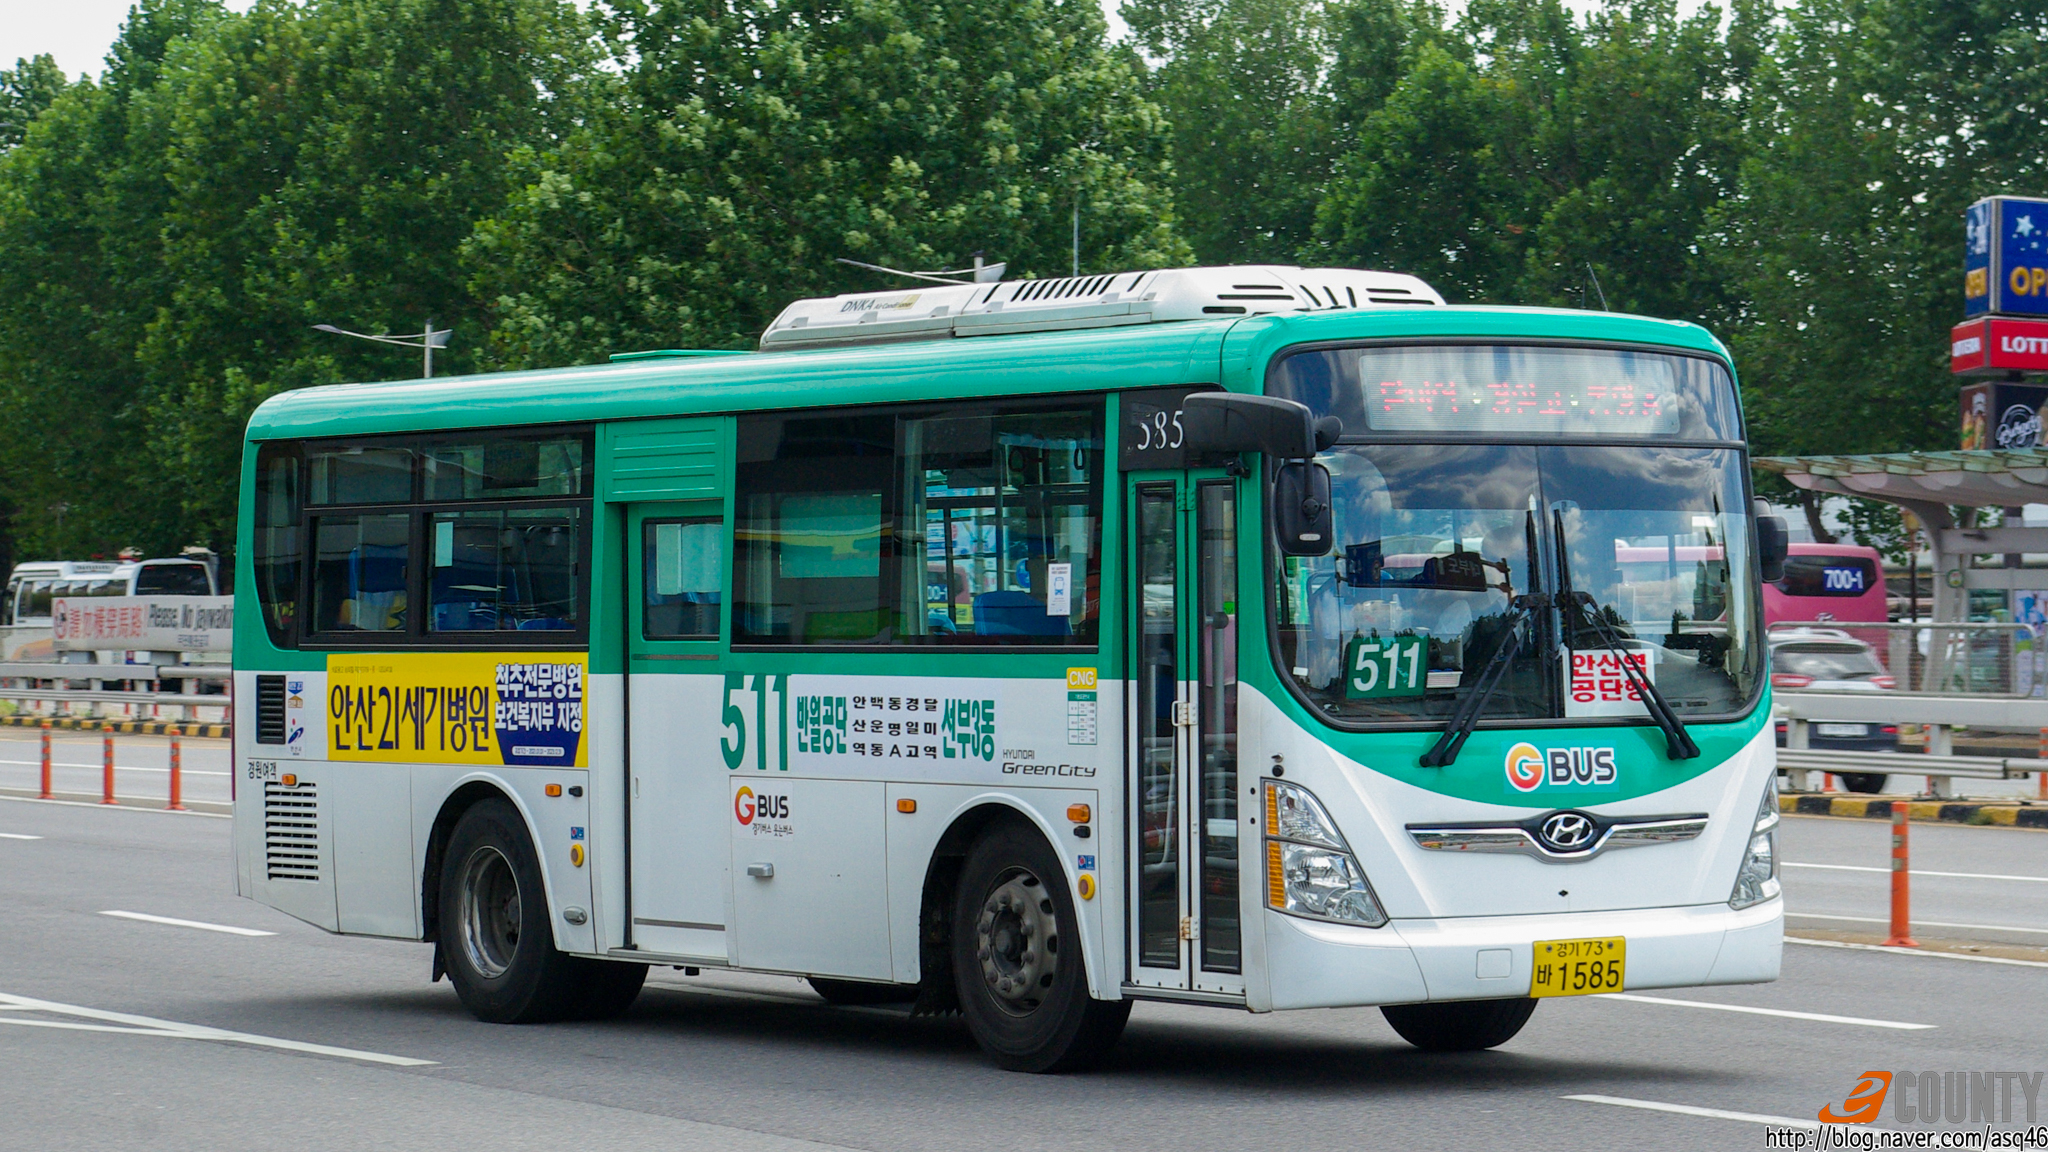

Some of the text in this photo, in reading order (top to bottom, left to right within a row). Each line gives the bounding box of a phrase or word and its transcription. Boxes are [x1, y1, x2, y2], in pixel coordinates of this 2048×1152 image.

[2009, 266, 2048, 297] OP
[841, 299, 876, 313] DNKA
[1824, 569, 1864, 590] 700-1
[495, 663, 582, 699] 척추전문병원
[1069, 671, 1095, 686] CNG
[1353, 641, 1420, 691] 511
[1573, 654, 1647, 677] 안산역
[331, 685, 490, 752] 안산21세기병원
[495, 701, 583, 733] 보건복지부 지정
[720, 671, 788, 771] 511
[797, 695, 848, 755] 반월공단
[941, 698, 995, 762] 선부3동
[1002, 748, 1036, 760] HYUNDAI
[248, 761, 277, 780] 경원여객
[1556, 941, 1603, 957] 경기 73
[1537, 960, 1620, 991] 바 1585
